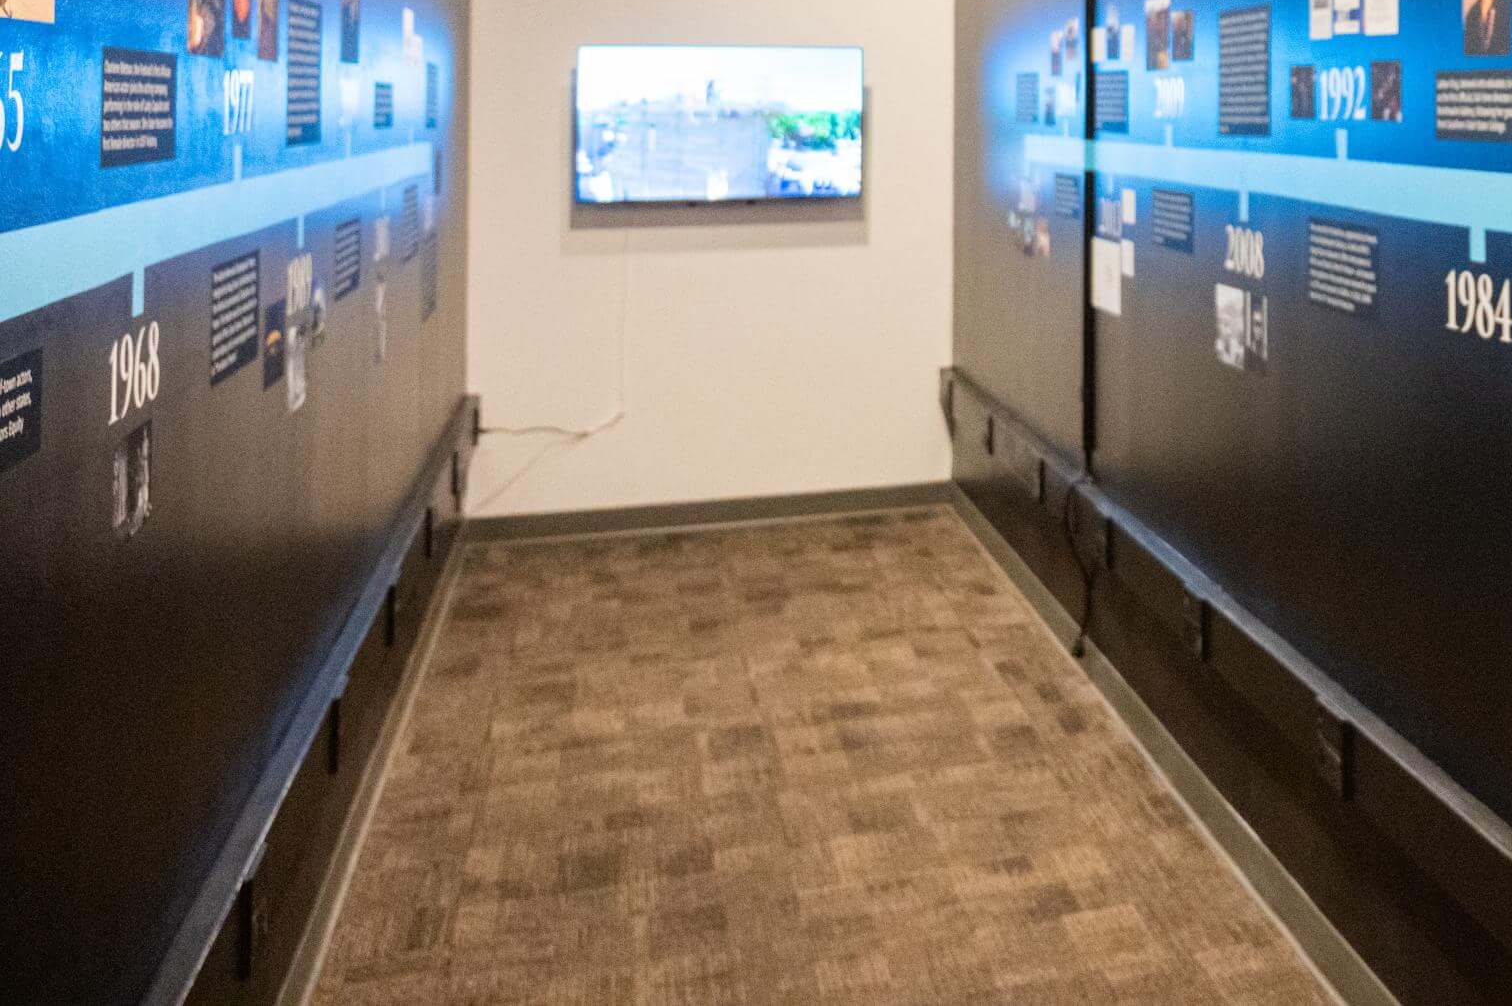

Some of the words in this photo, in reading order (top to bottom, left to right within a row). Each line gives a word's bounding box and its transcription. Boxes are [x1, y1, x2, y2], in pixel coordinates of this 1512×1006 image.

[0, 50, 24, 152] 5
[1320, 65, 1366, 121] 1992
[1445, 269, 1512, 343] 1984
[108, 321, 160, 425] 1968
